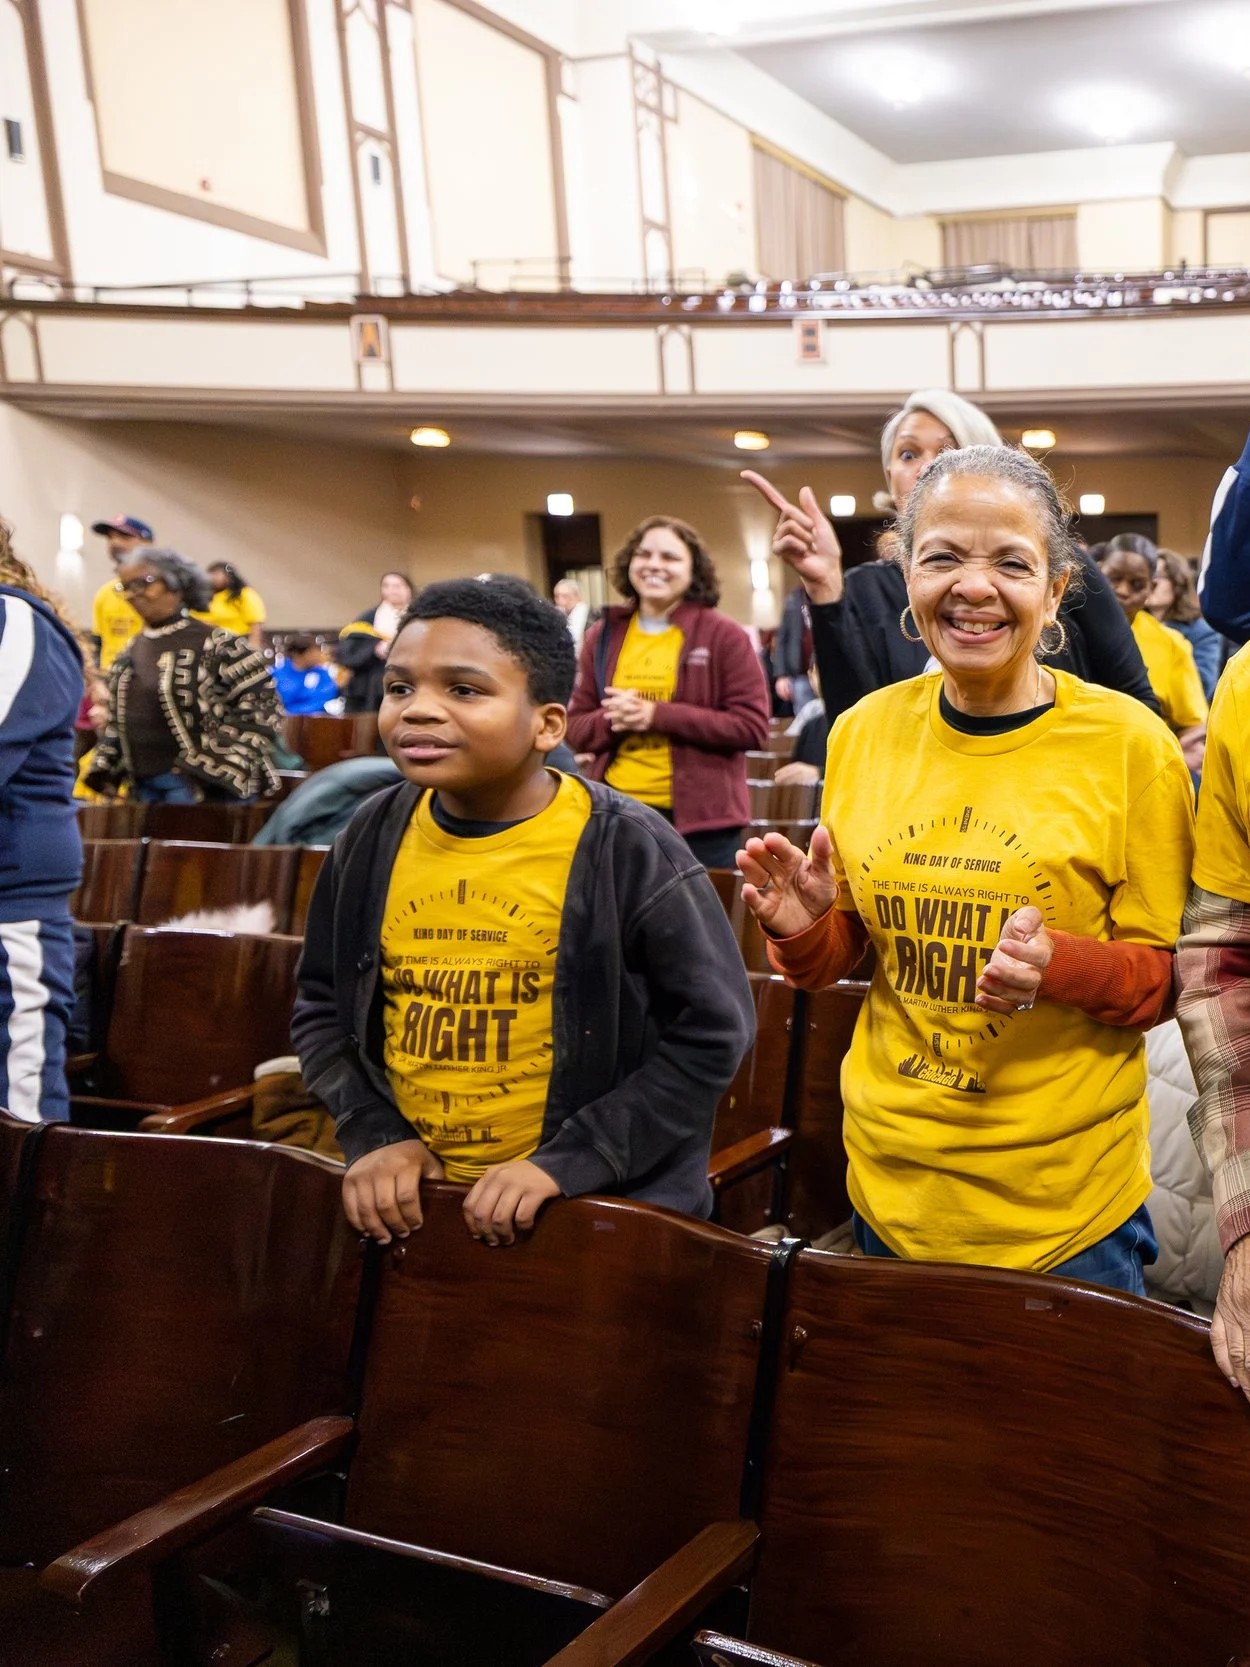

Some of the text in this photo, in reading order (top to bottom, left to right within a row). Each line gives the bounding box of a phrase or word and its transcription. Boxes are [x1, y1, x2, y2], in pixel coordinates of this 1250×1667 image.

[903, 852, 1001, 873] KING DAY OF SERVICE
[872, 880, 1030, 905] THE TIME IS ALWAYS RIGHT TO
[874, 894, 1018, 942] DO WHAT I
[413, 928, 509, 943] KING DAY OF SERVICE
[405, 955, 428, 965] TIME
[430, 956, 439, 965] IS
[441, 957, 484, 966] ALWAYS
[486, 958, 522, 969] RIGHT
[524, 960, 541, 969] TO
[423, 969, 501, 1004] WHAT
[511, 971, 541, 1005] IS
[903, 997, 929, 1009] MARTIN
[930, 1004, 959, 1014] LUTHER
[401, 1001, 517, 1062] RIGHT
[471, 1065, 494, 1073] KING
[918, 1068, 957, 1086] CHICAGO
